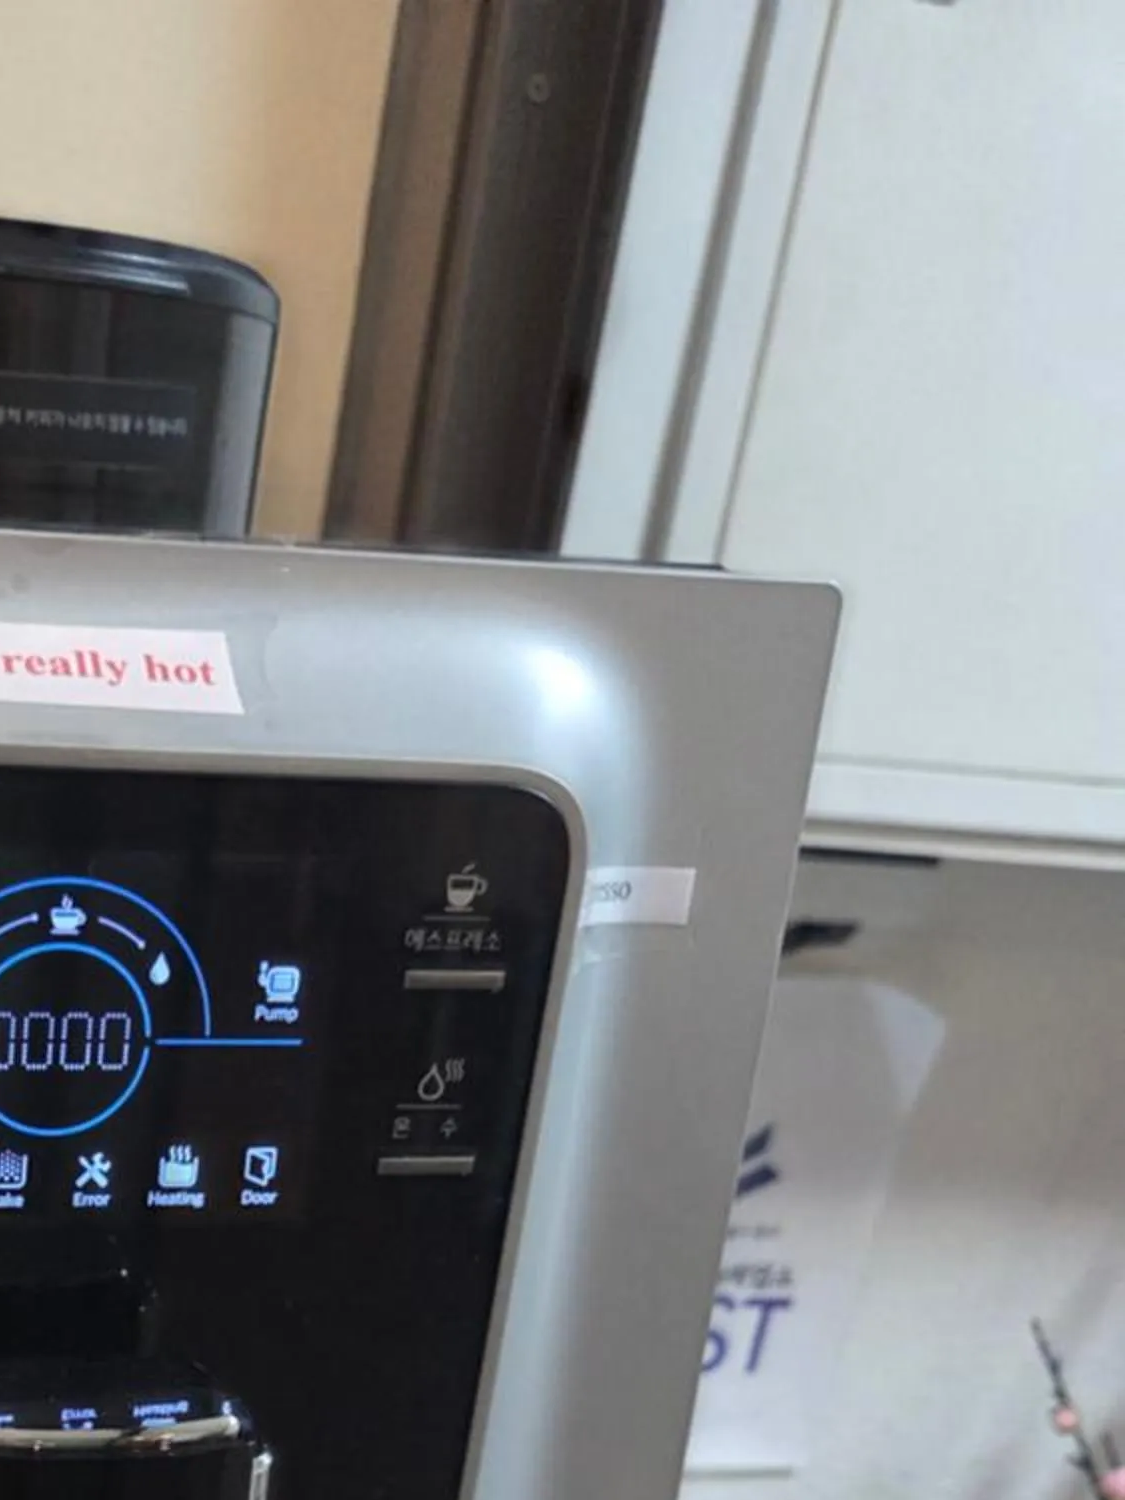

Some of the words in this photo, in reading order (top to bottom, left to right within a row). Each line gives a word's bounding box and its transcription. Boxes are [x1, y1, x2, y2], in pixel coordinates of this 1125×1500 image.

[1, 649, 129, 686] really
[144, 654, 217, 686] hot
[404, 928, 501, 952] 에스프레소
[254, 1004, 299, 1023] Pump
[73, 1191, 111, 1208] Error
[148, 1189, 204, 1210] Heating
[241, 1189, 276, 1206] Door
